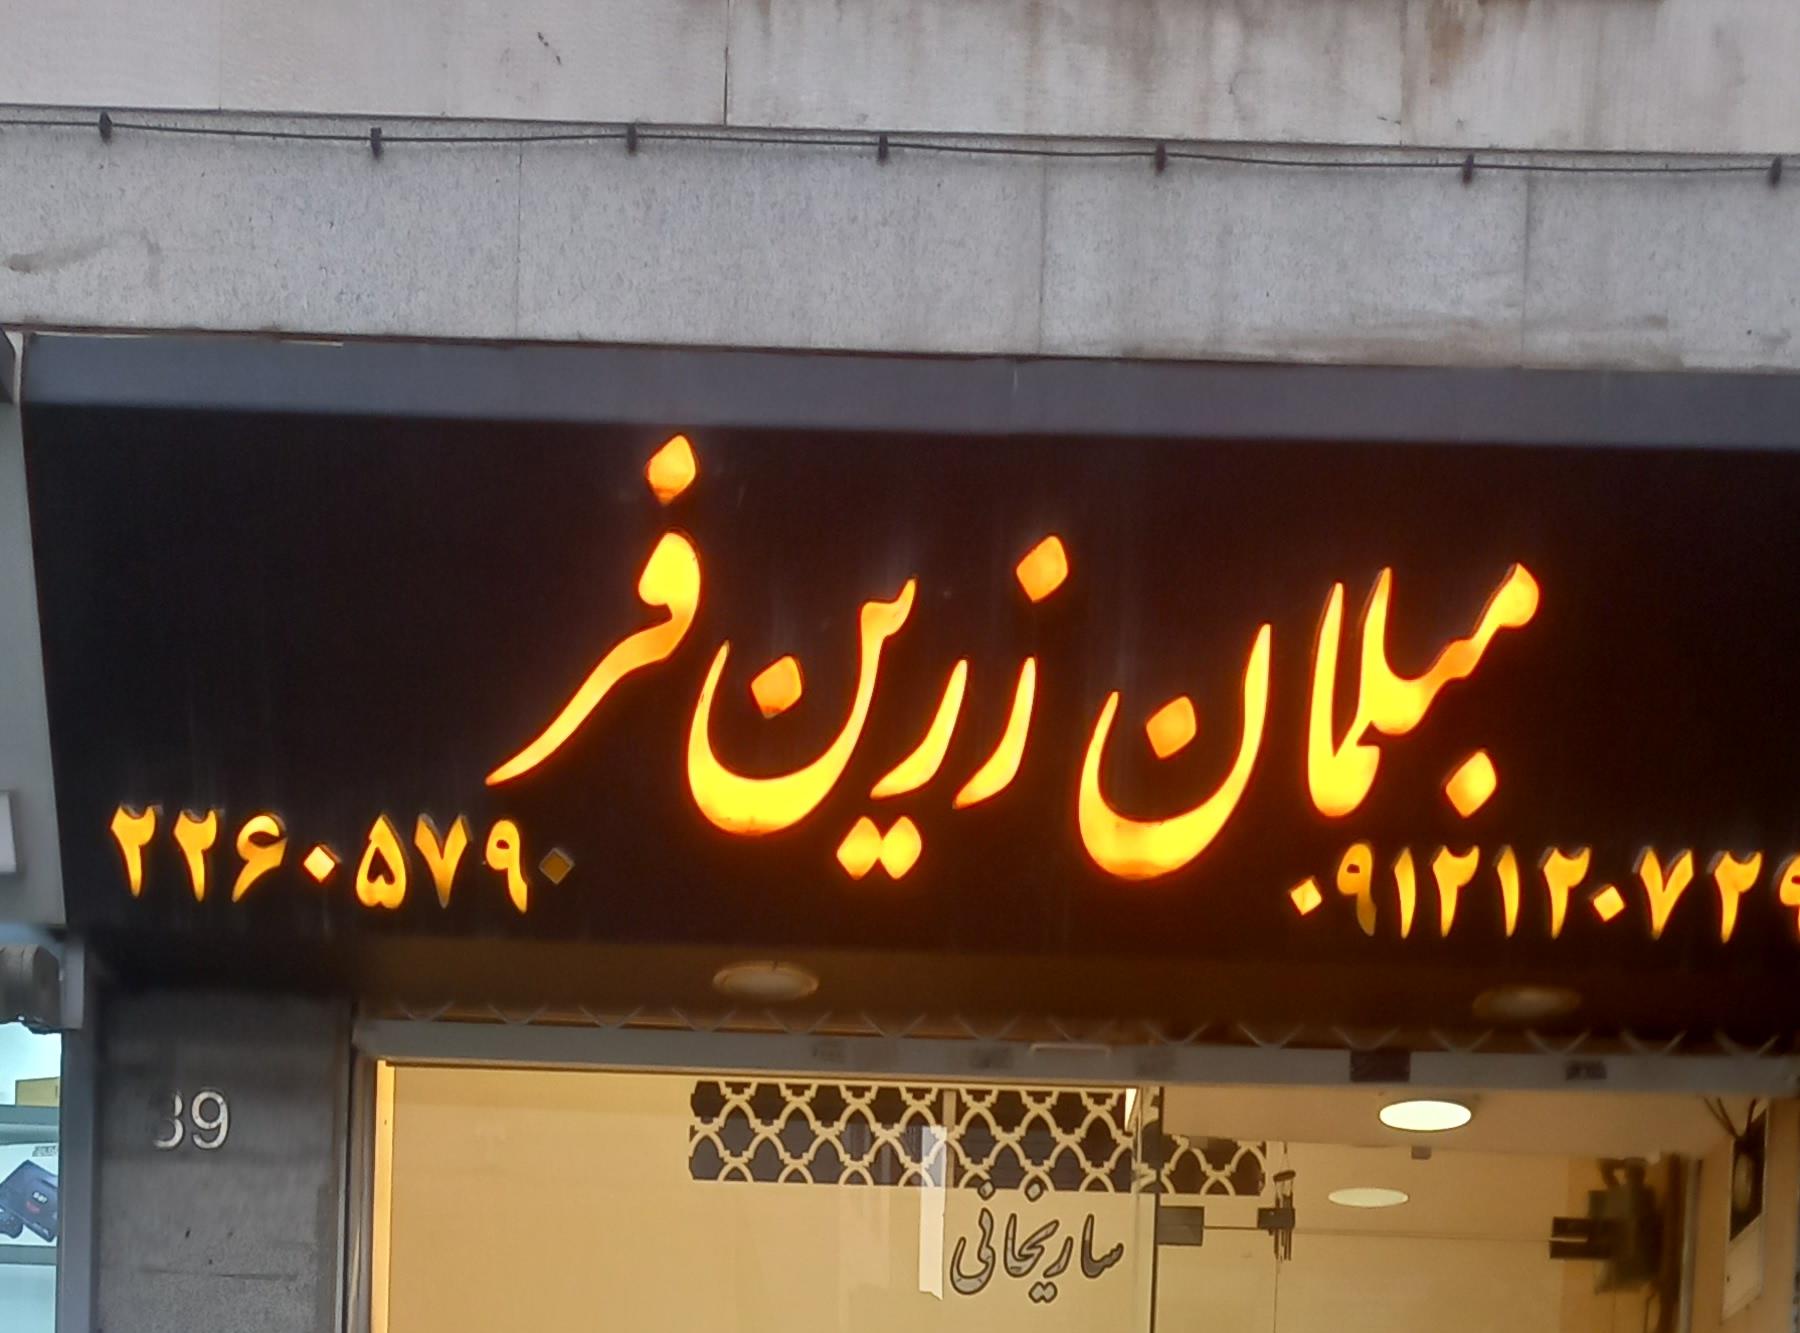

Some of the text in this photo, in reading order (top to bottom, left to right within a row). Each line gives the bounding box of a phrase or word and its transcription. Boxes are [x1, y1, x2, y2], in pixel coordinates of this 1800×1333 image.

[486, 434, 1540, 881] مبلمان زرین فر
[110, 806, 575, 913] ۲۲۶۰۵۷۹۰
